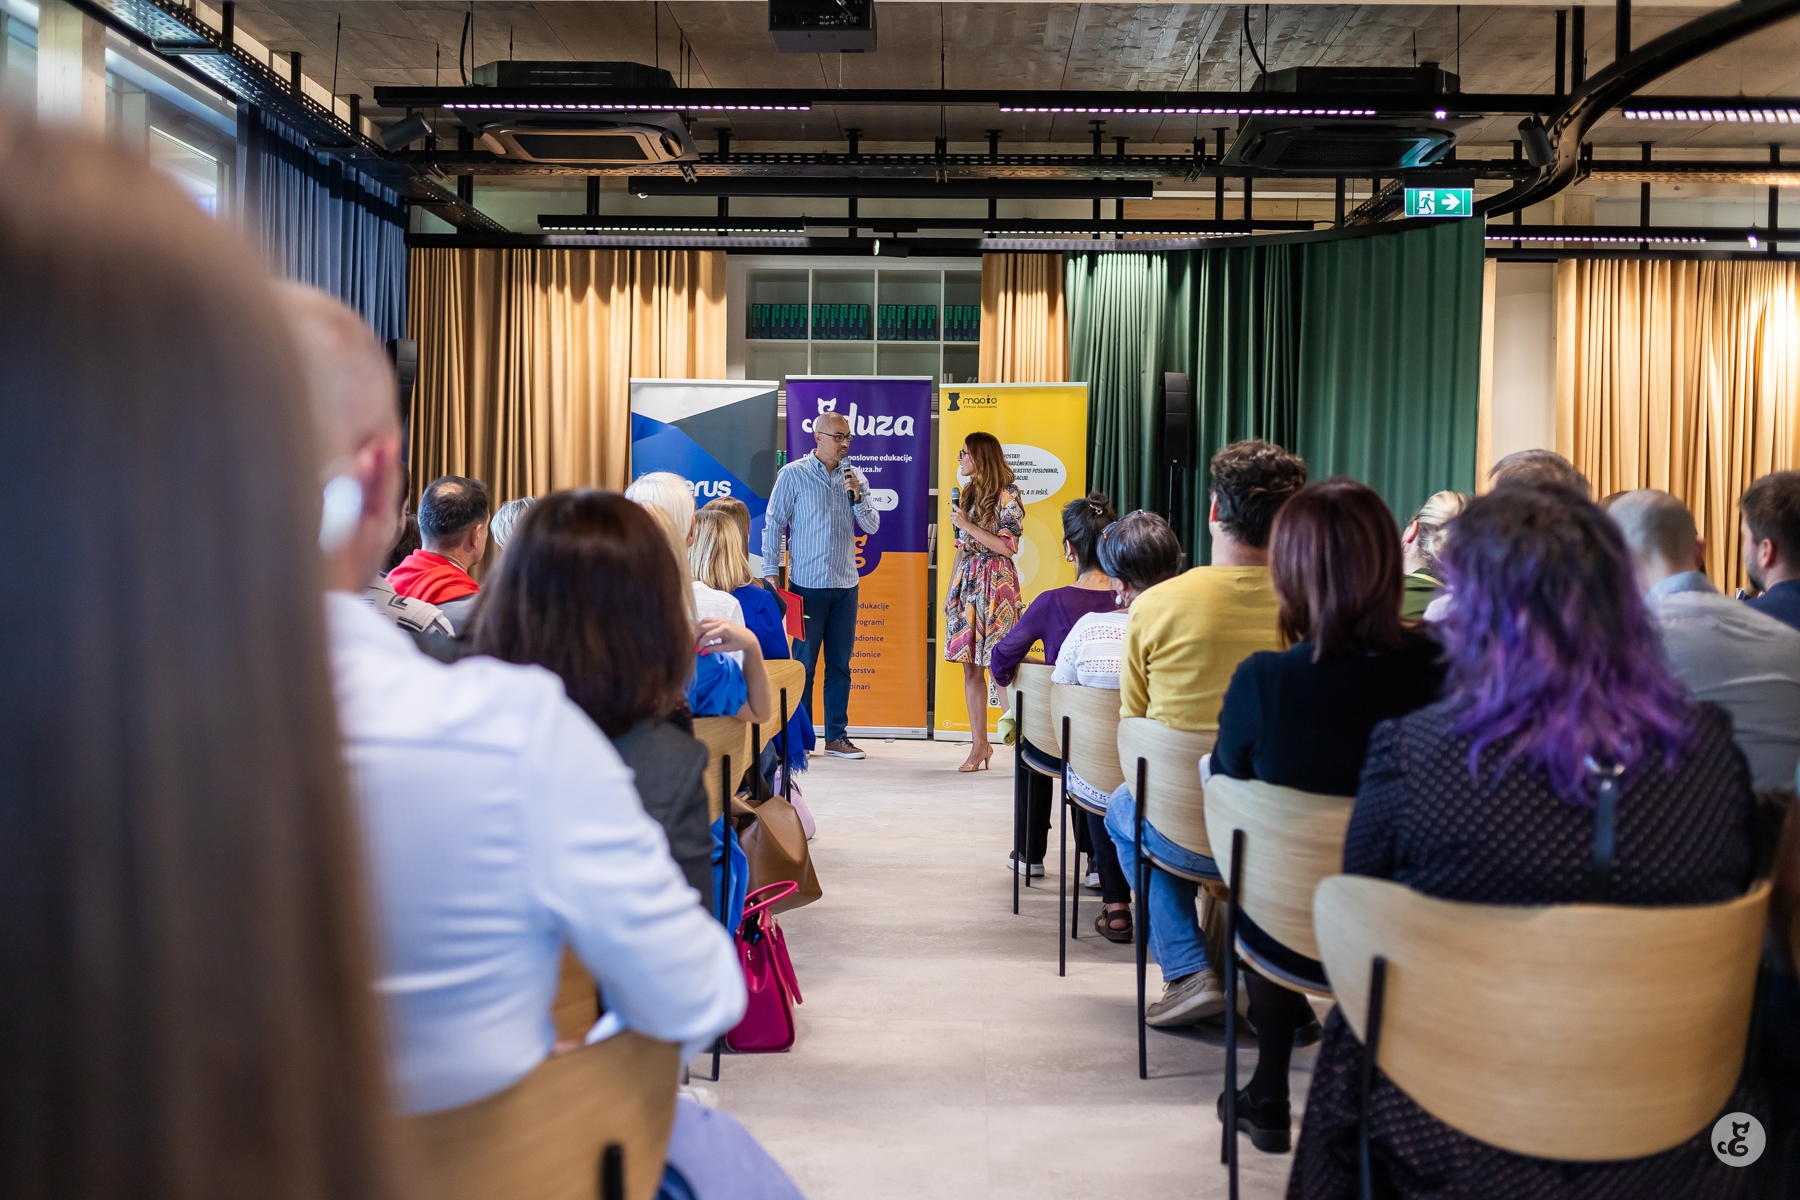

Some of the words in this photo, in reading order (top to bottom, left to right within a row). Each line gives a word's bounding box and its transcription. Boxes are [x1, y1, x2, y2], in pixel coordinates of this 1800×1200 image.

[879, 454, 913, 463] edukacije
[684, 480, 732, 497] erus
[856, 618, 885, 627] rogrami
[854, 634, 884, 642] adionice
[851, 650, 881, 658] adionice
[849, 667, 876, 675] torstva
